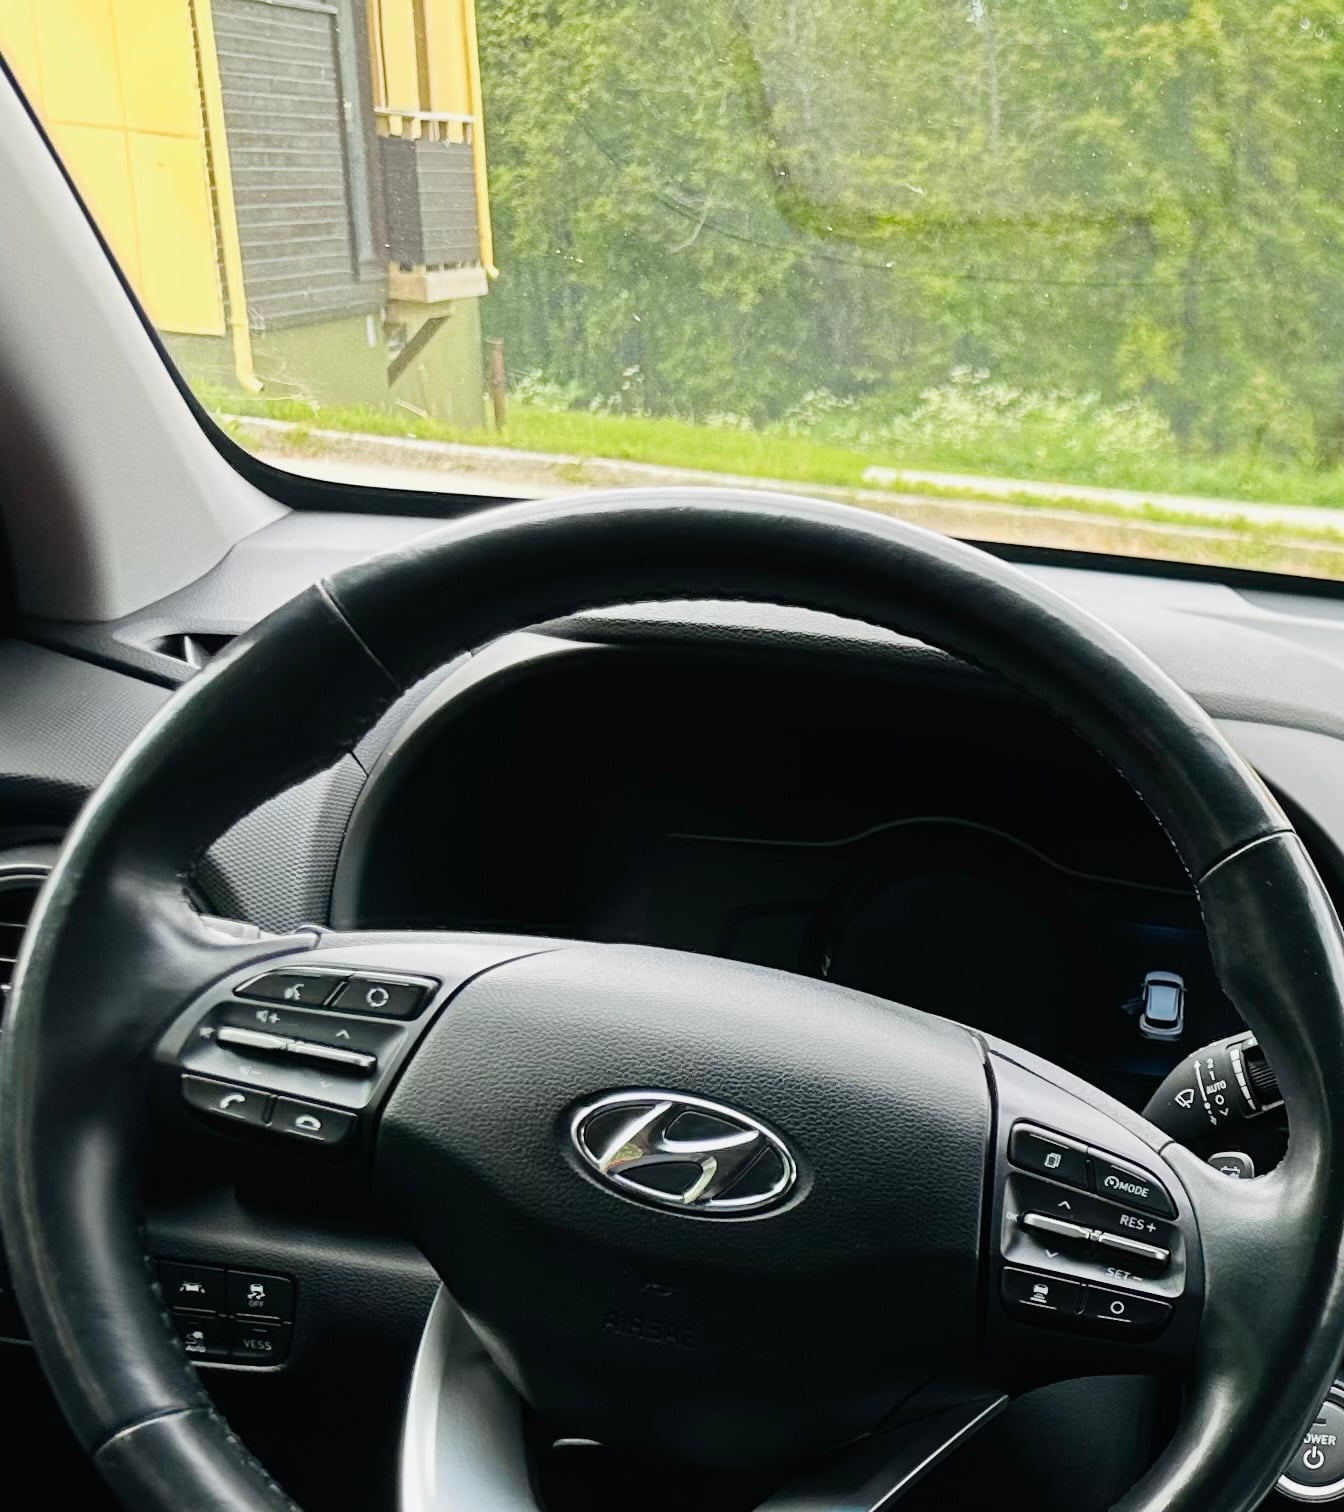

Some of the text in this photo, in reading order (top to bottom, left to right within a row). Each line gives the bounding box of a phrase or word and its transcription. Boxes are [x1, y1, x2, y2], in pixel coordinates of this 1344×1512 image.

[1206, 1080, 1227, 1095] AUTO
[1119, 1181, 1150, 1198] MODE
[243, 1338, 272, 1351] VESS
